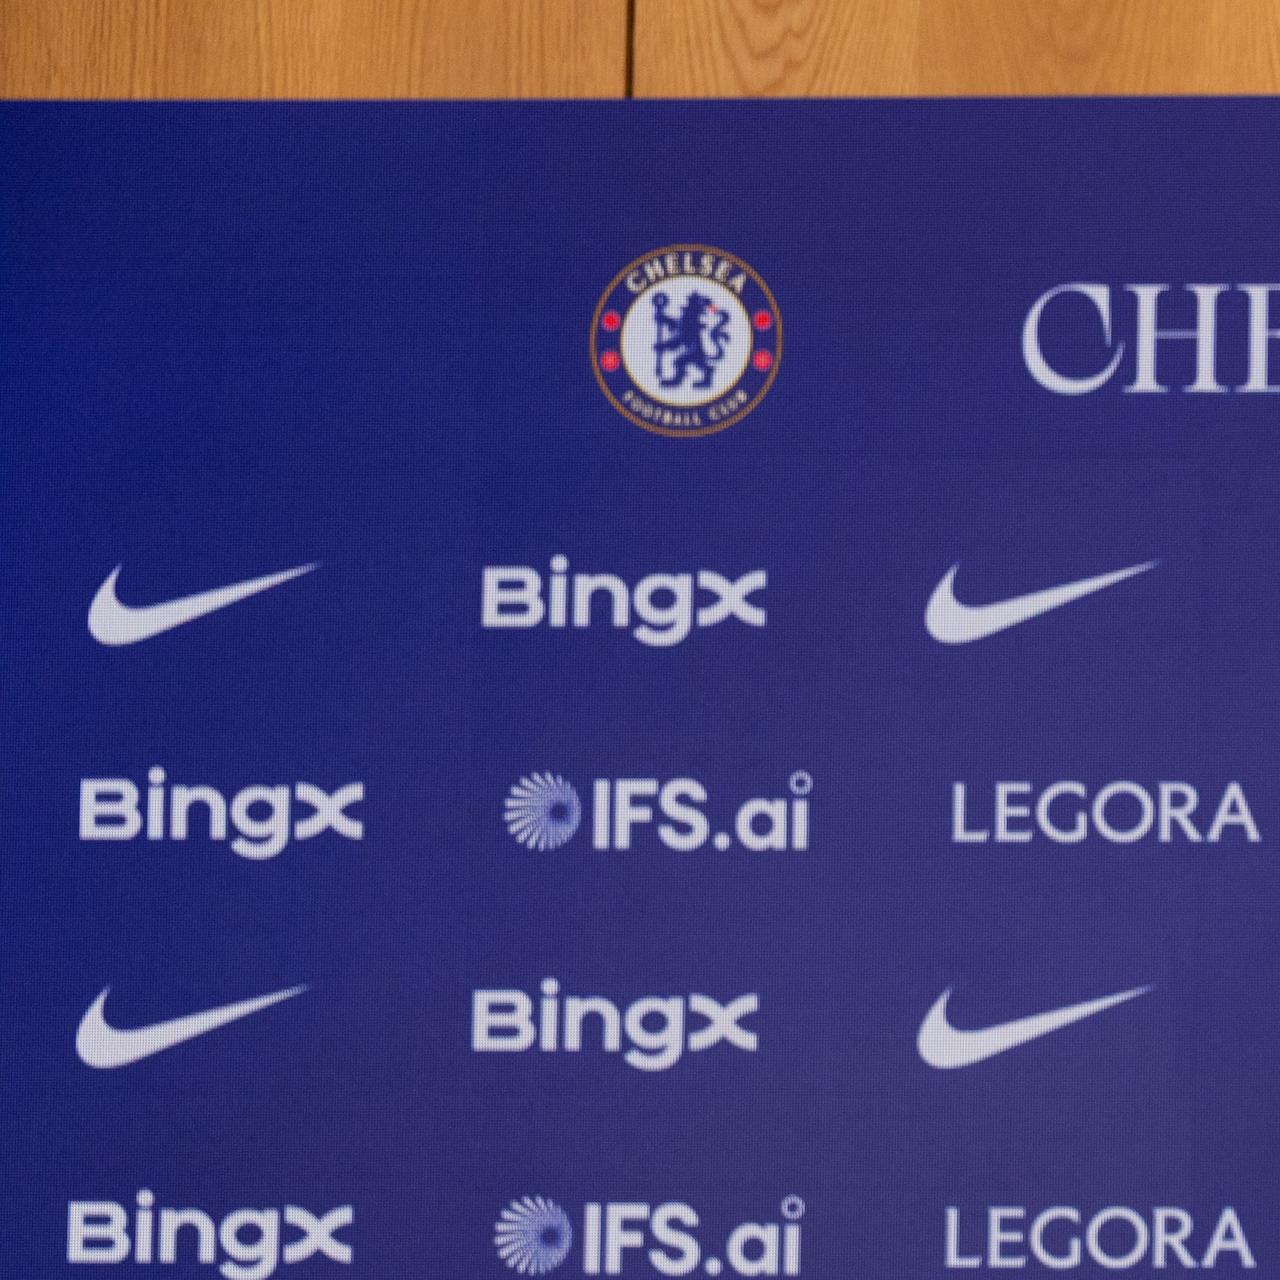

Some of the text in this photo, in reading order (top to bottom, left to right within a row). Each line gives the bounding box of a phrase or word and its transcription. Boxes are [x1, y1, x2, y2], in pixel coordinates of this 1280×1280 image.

[625, 251, 747, 293] CHELSEA
[592, 771, 813, 852] IFS.ai
[952, 780, 1262, 844] LEGORA
[583, 1195, 805, 1277] IFS.ai
[944, 1205, 1257, 1270] LEGORA
